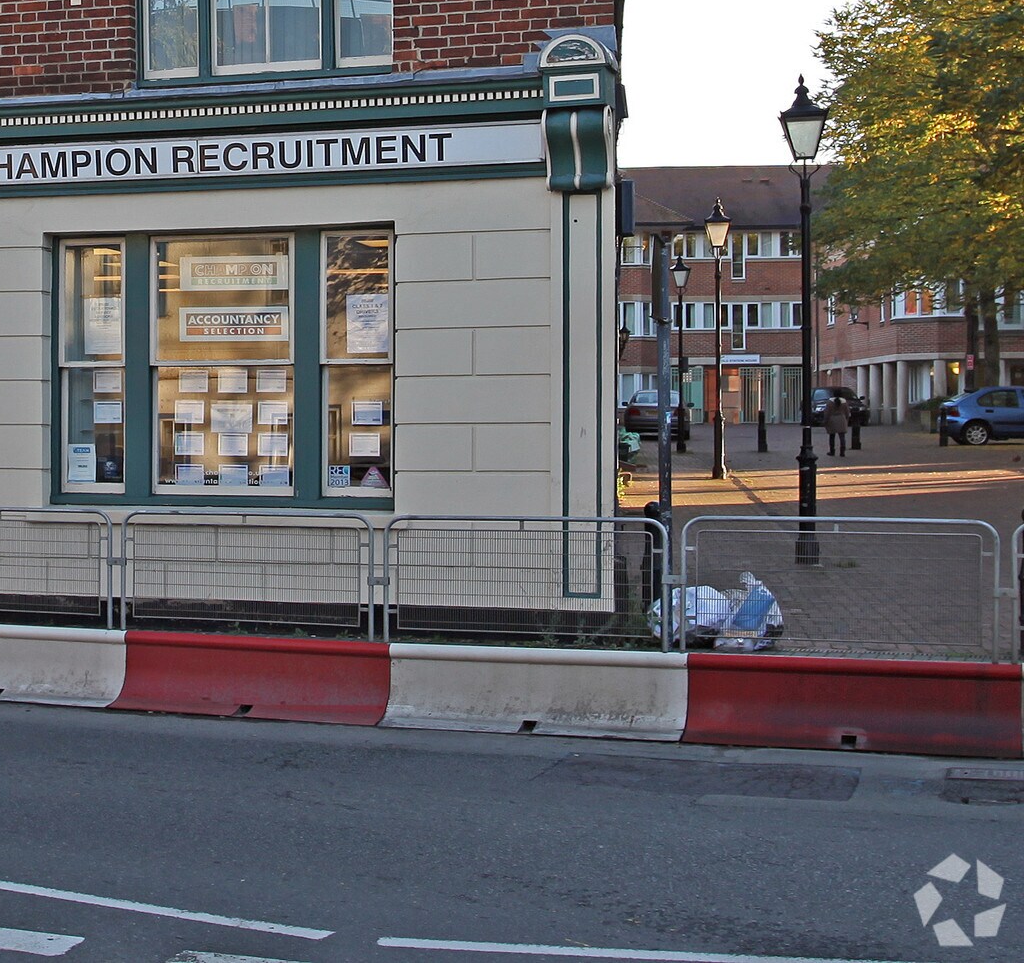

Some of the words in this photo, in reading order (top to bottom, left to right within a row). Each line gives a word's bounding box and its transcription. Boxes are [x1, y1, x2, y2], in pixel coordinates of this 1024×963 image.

[172, 132, 453, 173] RECRUITMENT
[197, 277, 273, 285] RECRUITMENT
[187, 314, 280, 325] ACCOUNTANCY
[203, 327, 265, 335] SELECTION
